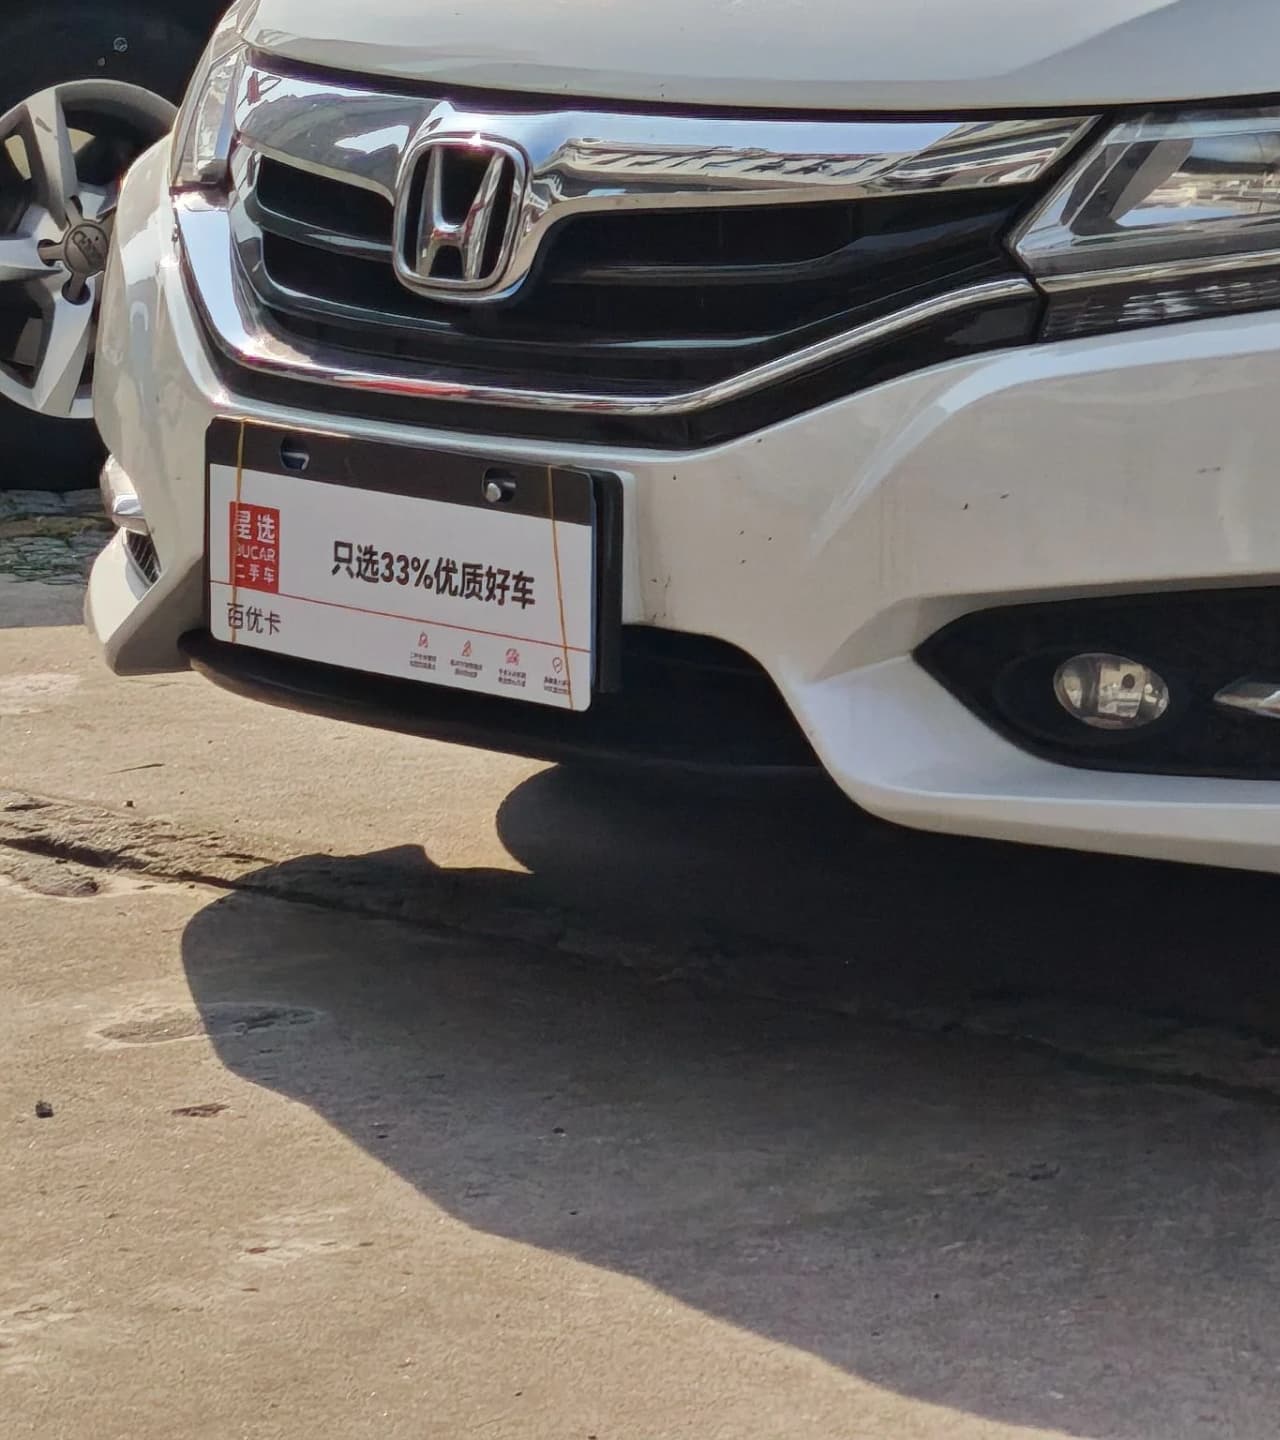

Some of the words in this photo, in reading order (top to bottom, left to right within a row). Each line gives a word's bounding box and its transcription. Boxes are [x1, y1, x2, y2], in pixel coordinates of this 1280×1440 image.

[235, 563, 275, 585] 二手车
[331, 539, 537, 610] 只选33%优质好车
[227, 602, 282, 636] 百优卡
